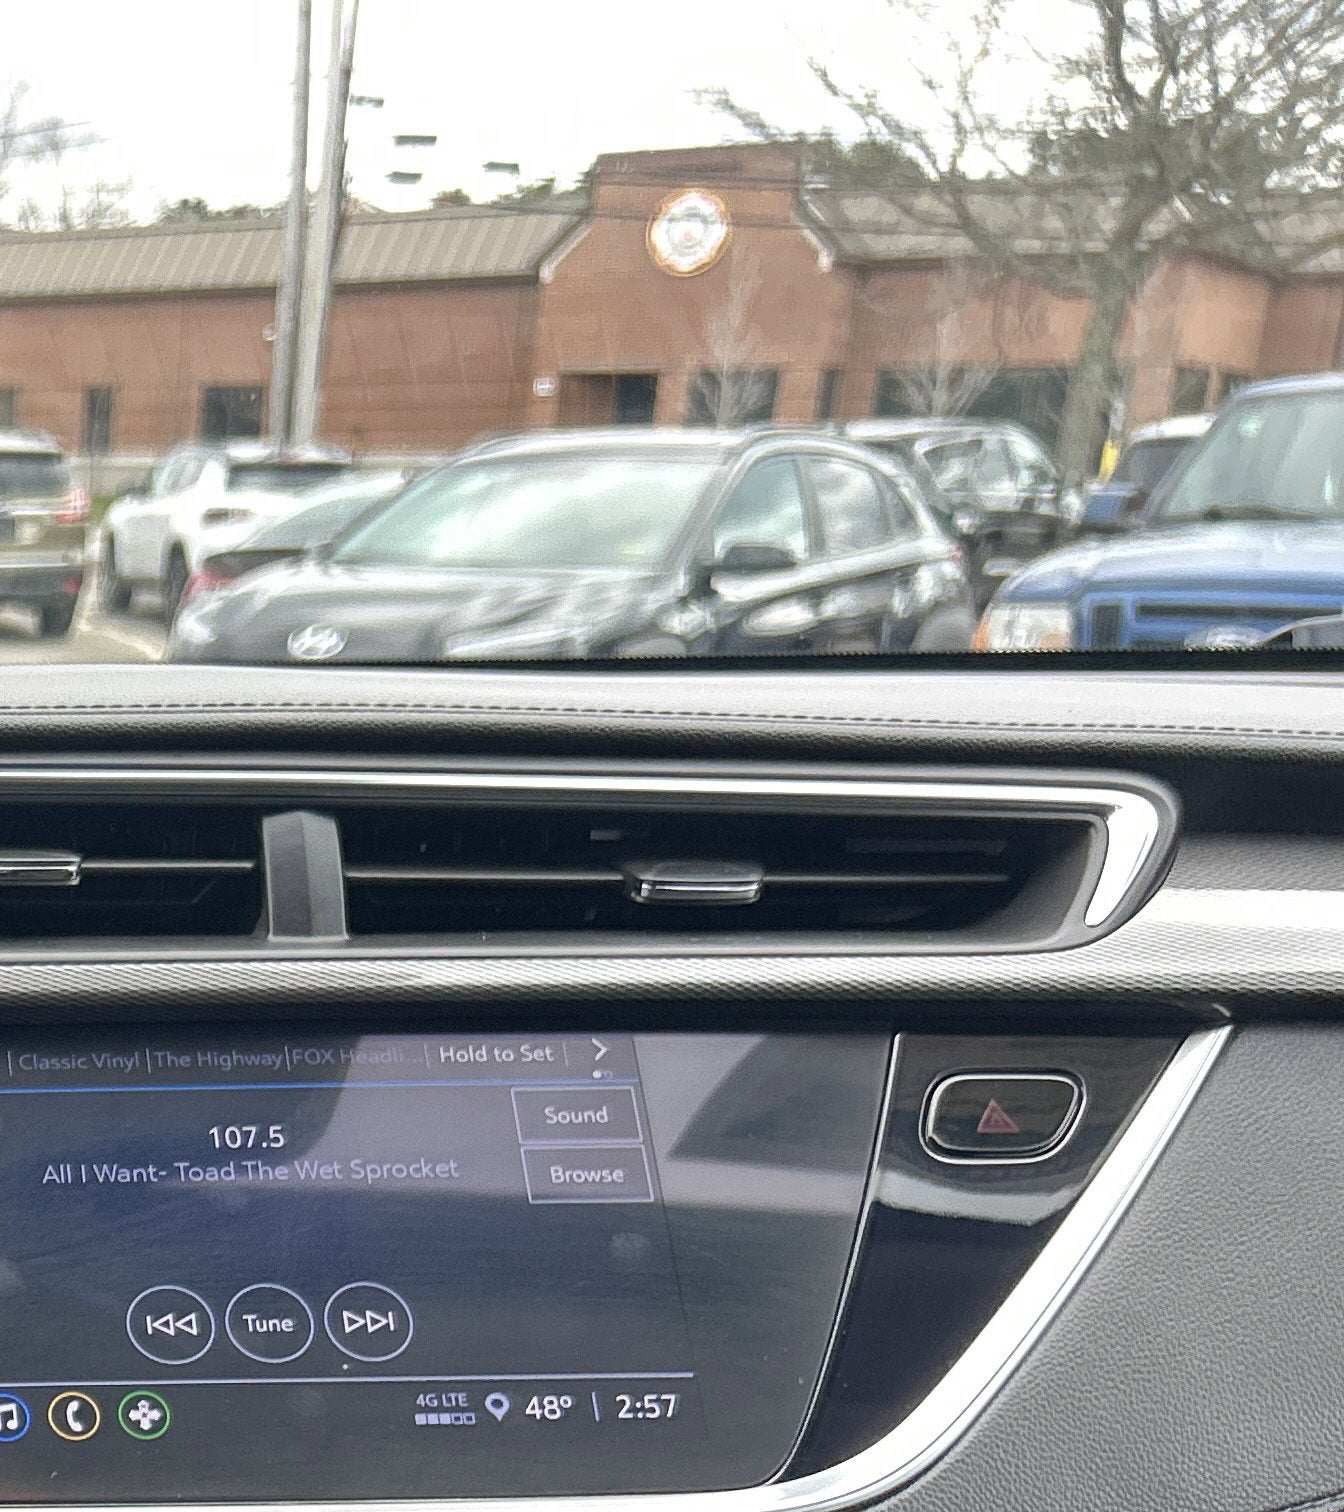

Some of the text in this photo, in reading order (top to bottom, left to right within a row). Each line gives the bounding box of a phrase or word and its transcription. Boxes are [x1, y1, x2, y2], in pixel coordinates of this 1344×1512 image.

[18, 1051, 140, 1074] Classic Vinyl
[154, 1049, 283, 1072] The Highway
[293, 1048, 333, 1066] FOX
[439, 1044, 555, 1063] Hold to Set
[544, 1105, 608, 1125] Sound
[208, 1125, 286, 1149] 107.5
[42, 1163, 72, 1184] All
[93, 1162, 168, 1183] Want-
[173, 1161, 235, 1183] Toad
[241, 1160, 290, 1181] The
[294, 1159, 343, 1181] Wet
[350, 1157, 460, 1185] Sprocket
[550, 1165, 625, 1185] Browse
[242, 1313, 295, 1334] Tune
[416, 1393, 469, 1408] 4G LTE
[615, 1393, 677, 1419] 2:57
